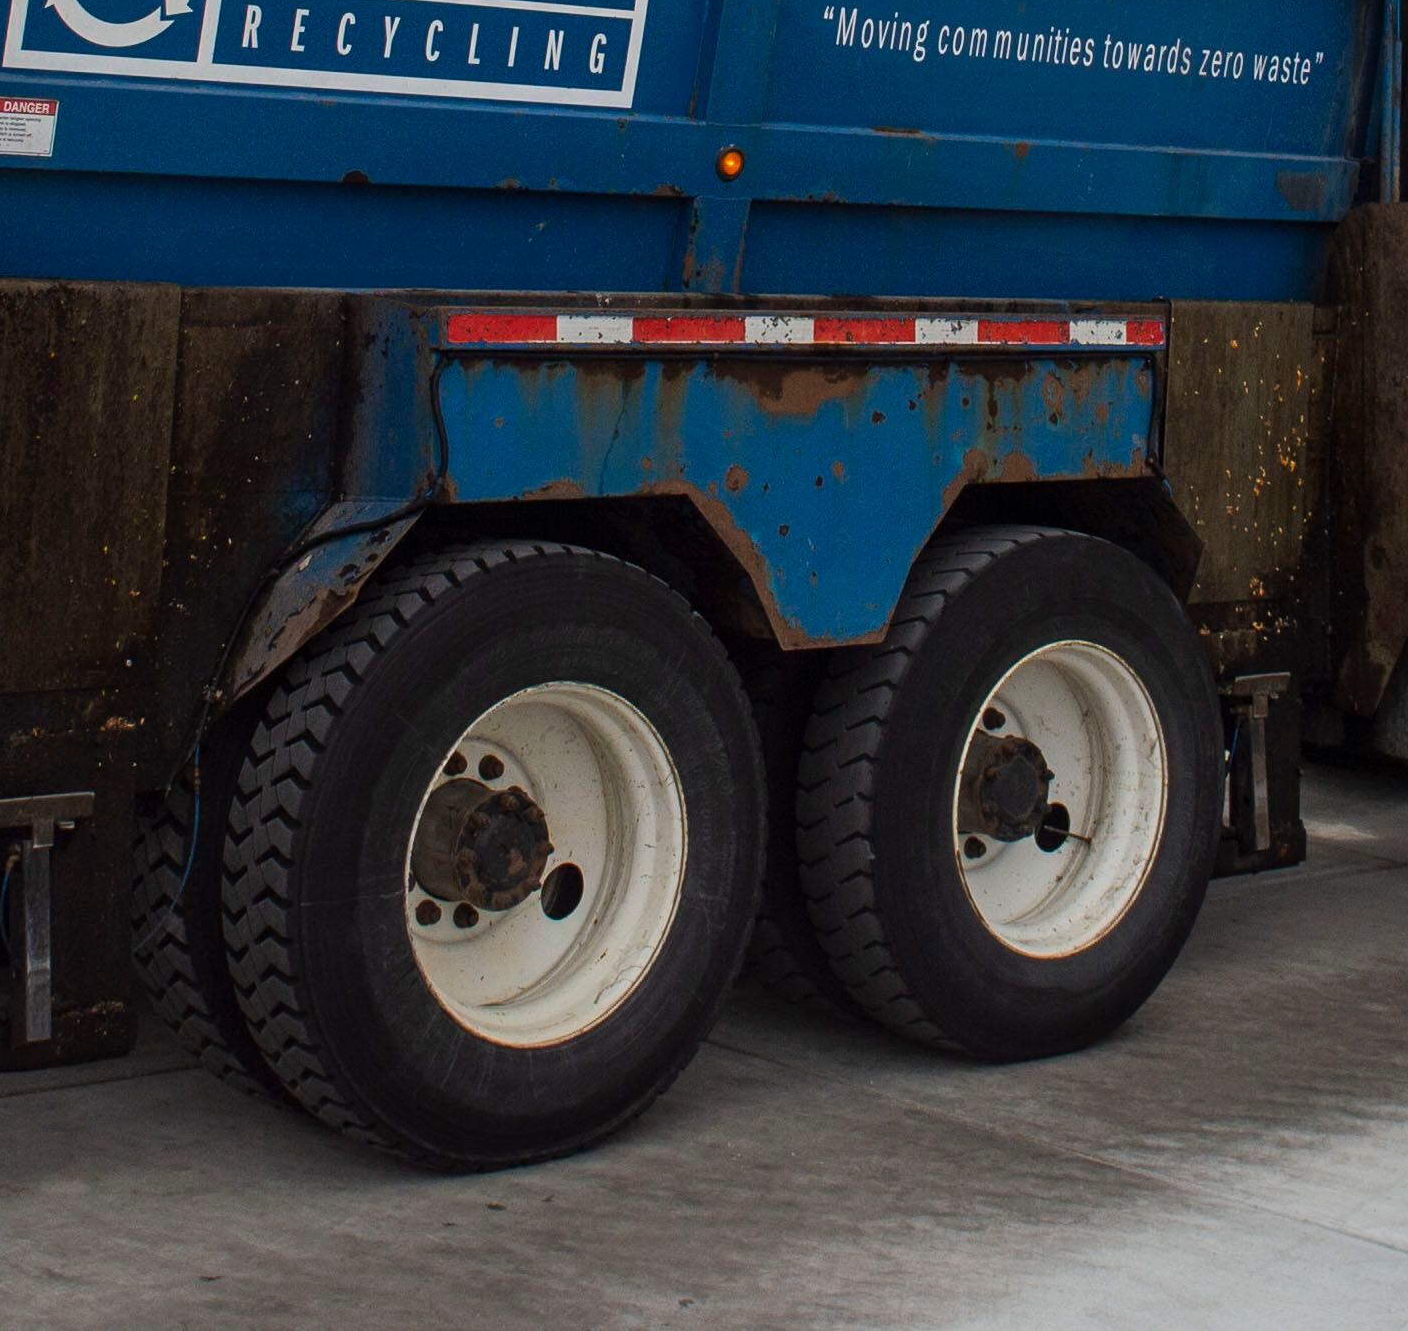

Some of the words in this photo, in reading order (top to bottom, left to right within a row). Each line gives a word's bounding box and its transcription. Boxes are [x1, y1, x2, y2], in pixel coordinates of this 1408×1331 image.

[241, 4, 607, 74] RECYCLING
[937, 25, 1094, 67] communities
[1103, 33, 1191, 75] towards
[1198, 48, 1244, 80] zero
[3, 100, 50, 114] DANGER
